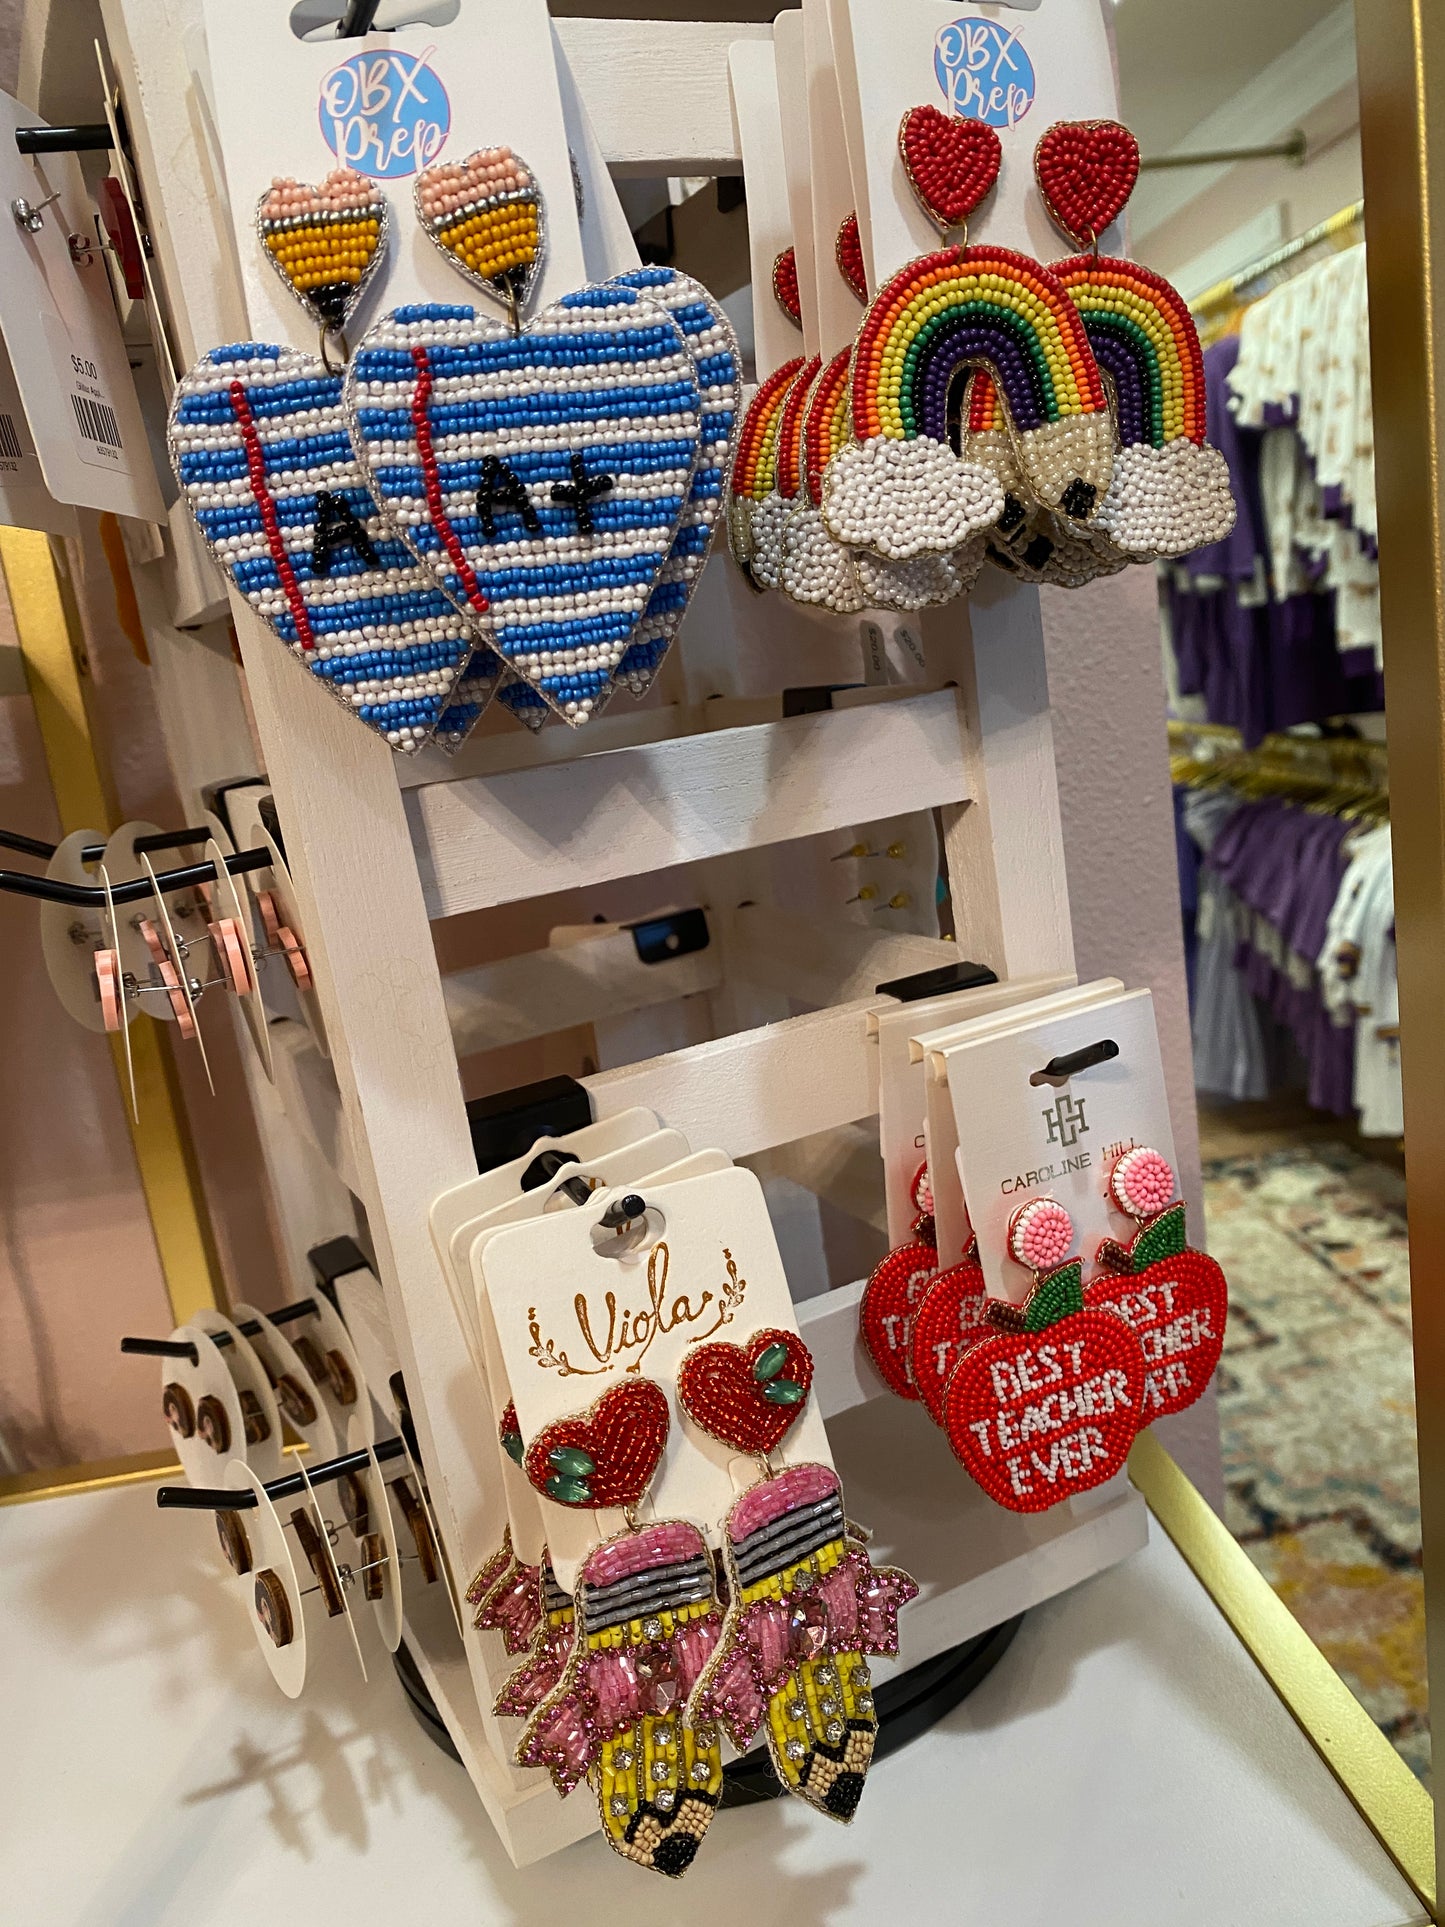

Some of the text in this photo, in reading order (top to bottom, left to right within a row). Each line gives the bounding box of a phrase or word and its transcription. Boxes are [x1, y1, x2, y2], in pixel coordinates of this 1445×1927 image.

[320, 45, 437, 123] OBX
[935, 24, 1025, 83] OBX
[70, 354, 98, 380] $5.00
[476, 453, 614, 538] A+
[868, 626, 881, 671] $20.00
[1001, 1152, 1092, 1195] CAROLINE
[574, 1242, 714, 1373] Viola
[989, 1340, 1086, 1403] BEST
[969, 1369, 1132, 1457] TEACHER
[1005, 1426, 1109, 1496] EVER
